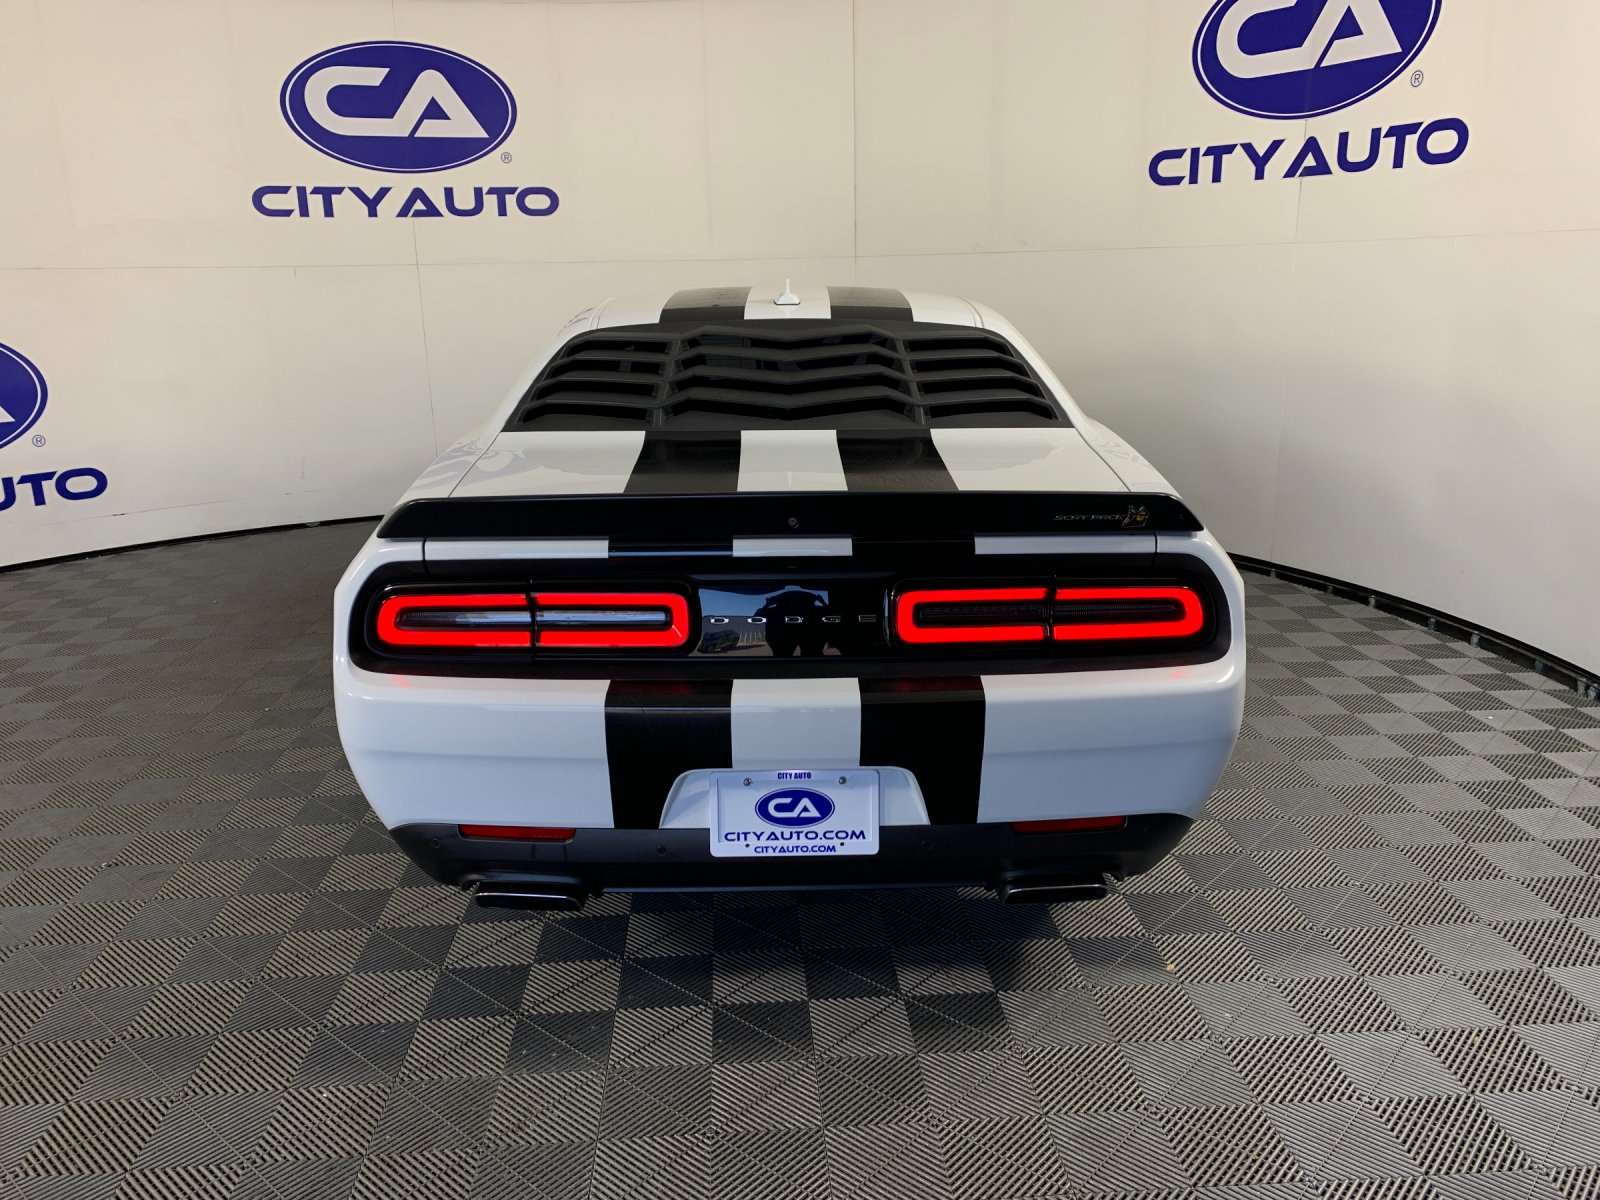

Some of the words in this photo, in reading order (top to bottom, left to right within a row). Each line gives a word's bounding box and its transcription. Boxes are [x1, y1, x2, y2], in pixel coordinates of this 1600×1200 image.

[1215, 0, 1403, 79] CA
[303, 65, 490, 138] CA
[709, 614, 877, 624] DODGE
[777, 772, 793, 780] CITY
[794, 772, 812, 780] AUTO
[767, 797, 822, 818] CA
[724, 830, 866, 842] CITYAUTO.COM
[754, 845, 837, 854] CITYAUTO.COM
